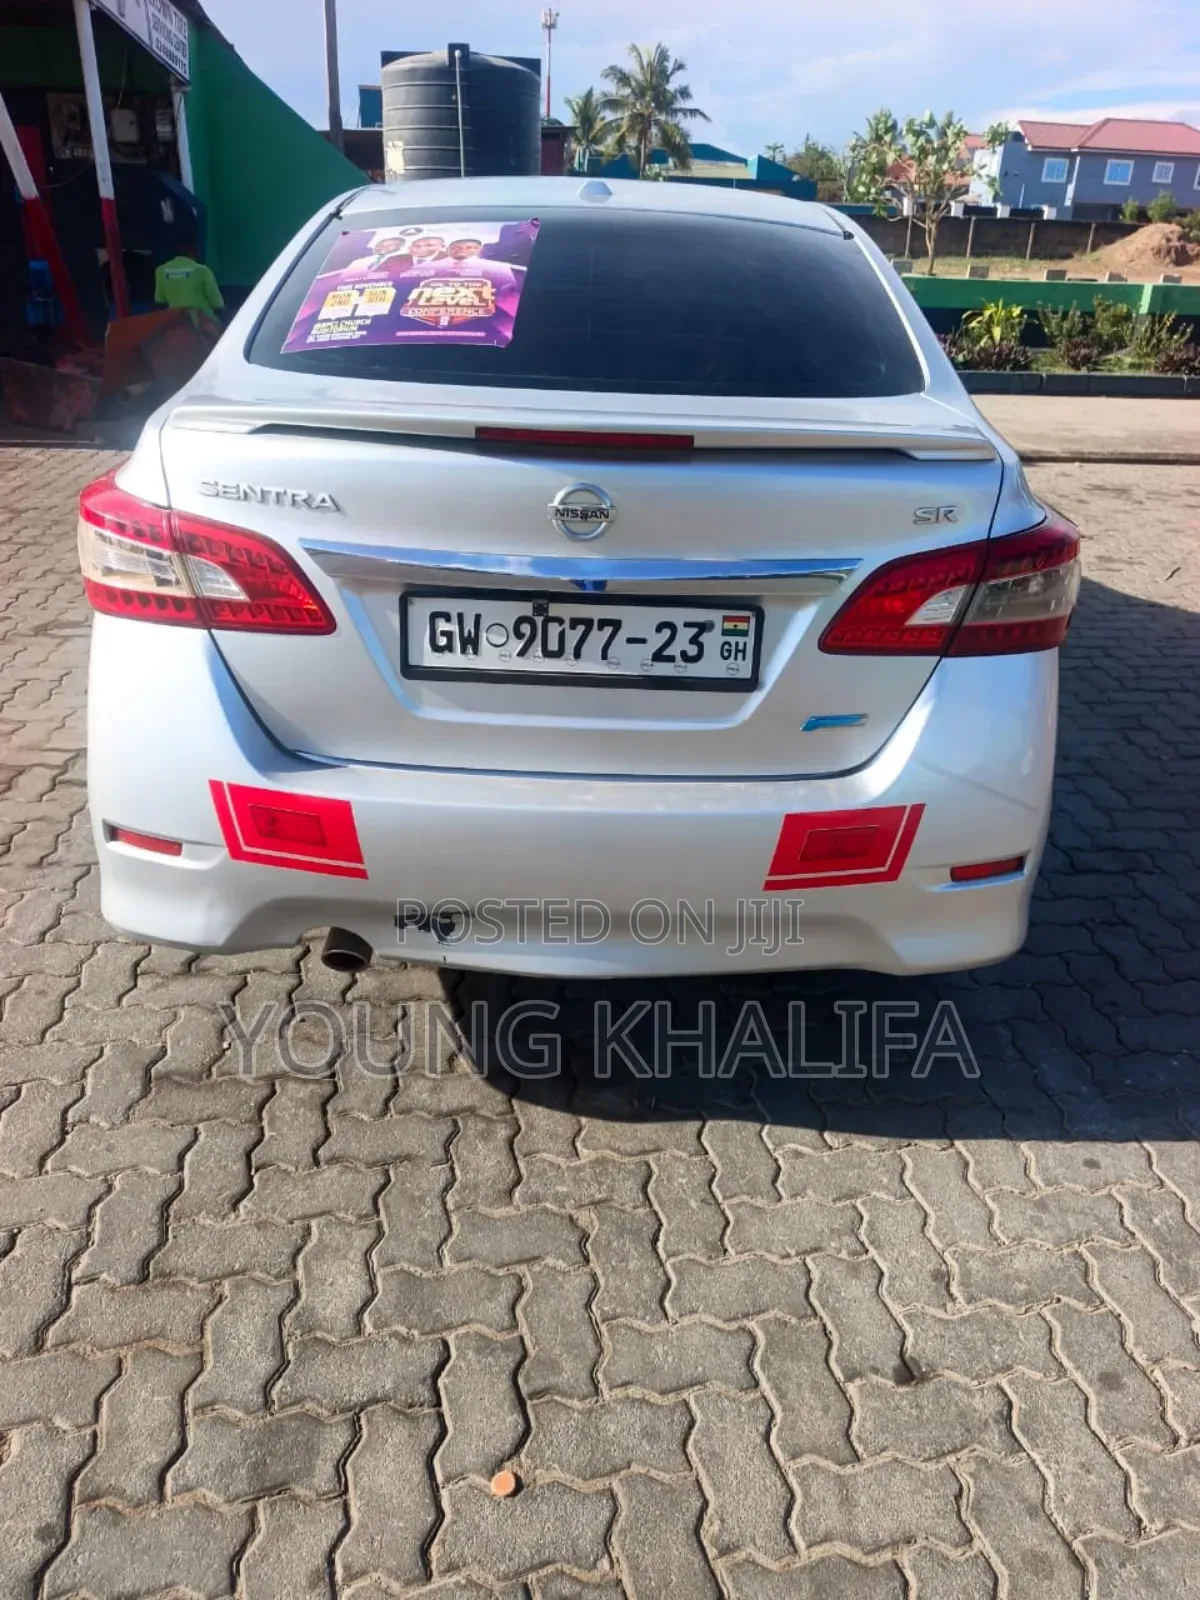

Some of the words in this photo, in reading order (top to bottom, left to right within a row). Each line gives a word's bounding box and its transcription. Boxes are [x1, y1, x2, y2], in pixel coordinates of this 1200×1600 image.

[199, 480, 341, 513] SENTRA
[555, 508, 610, 520] NISSAN
[913, 505, 959, 525] SR
[429, 611, 482, 655] GW
[720, 641, 747, 661] GH
